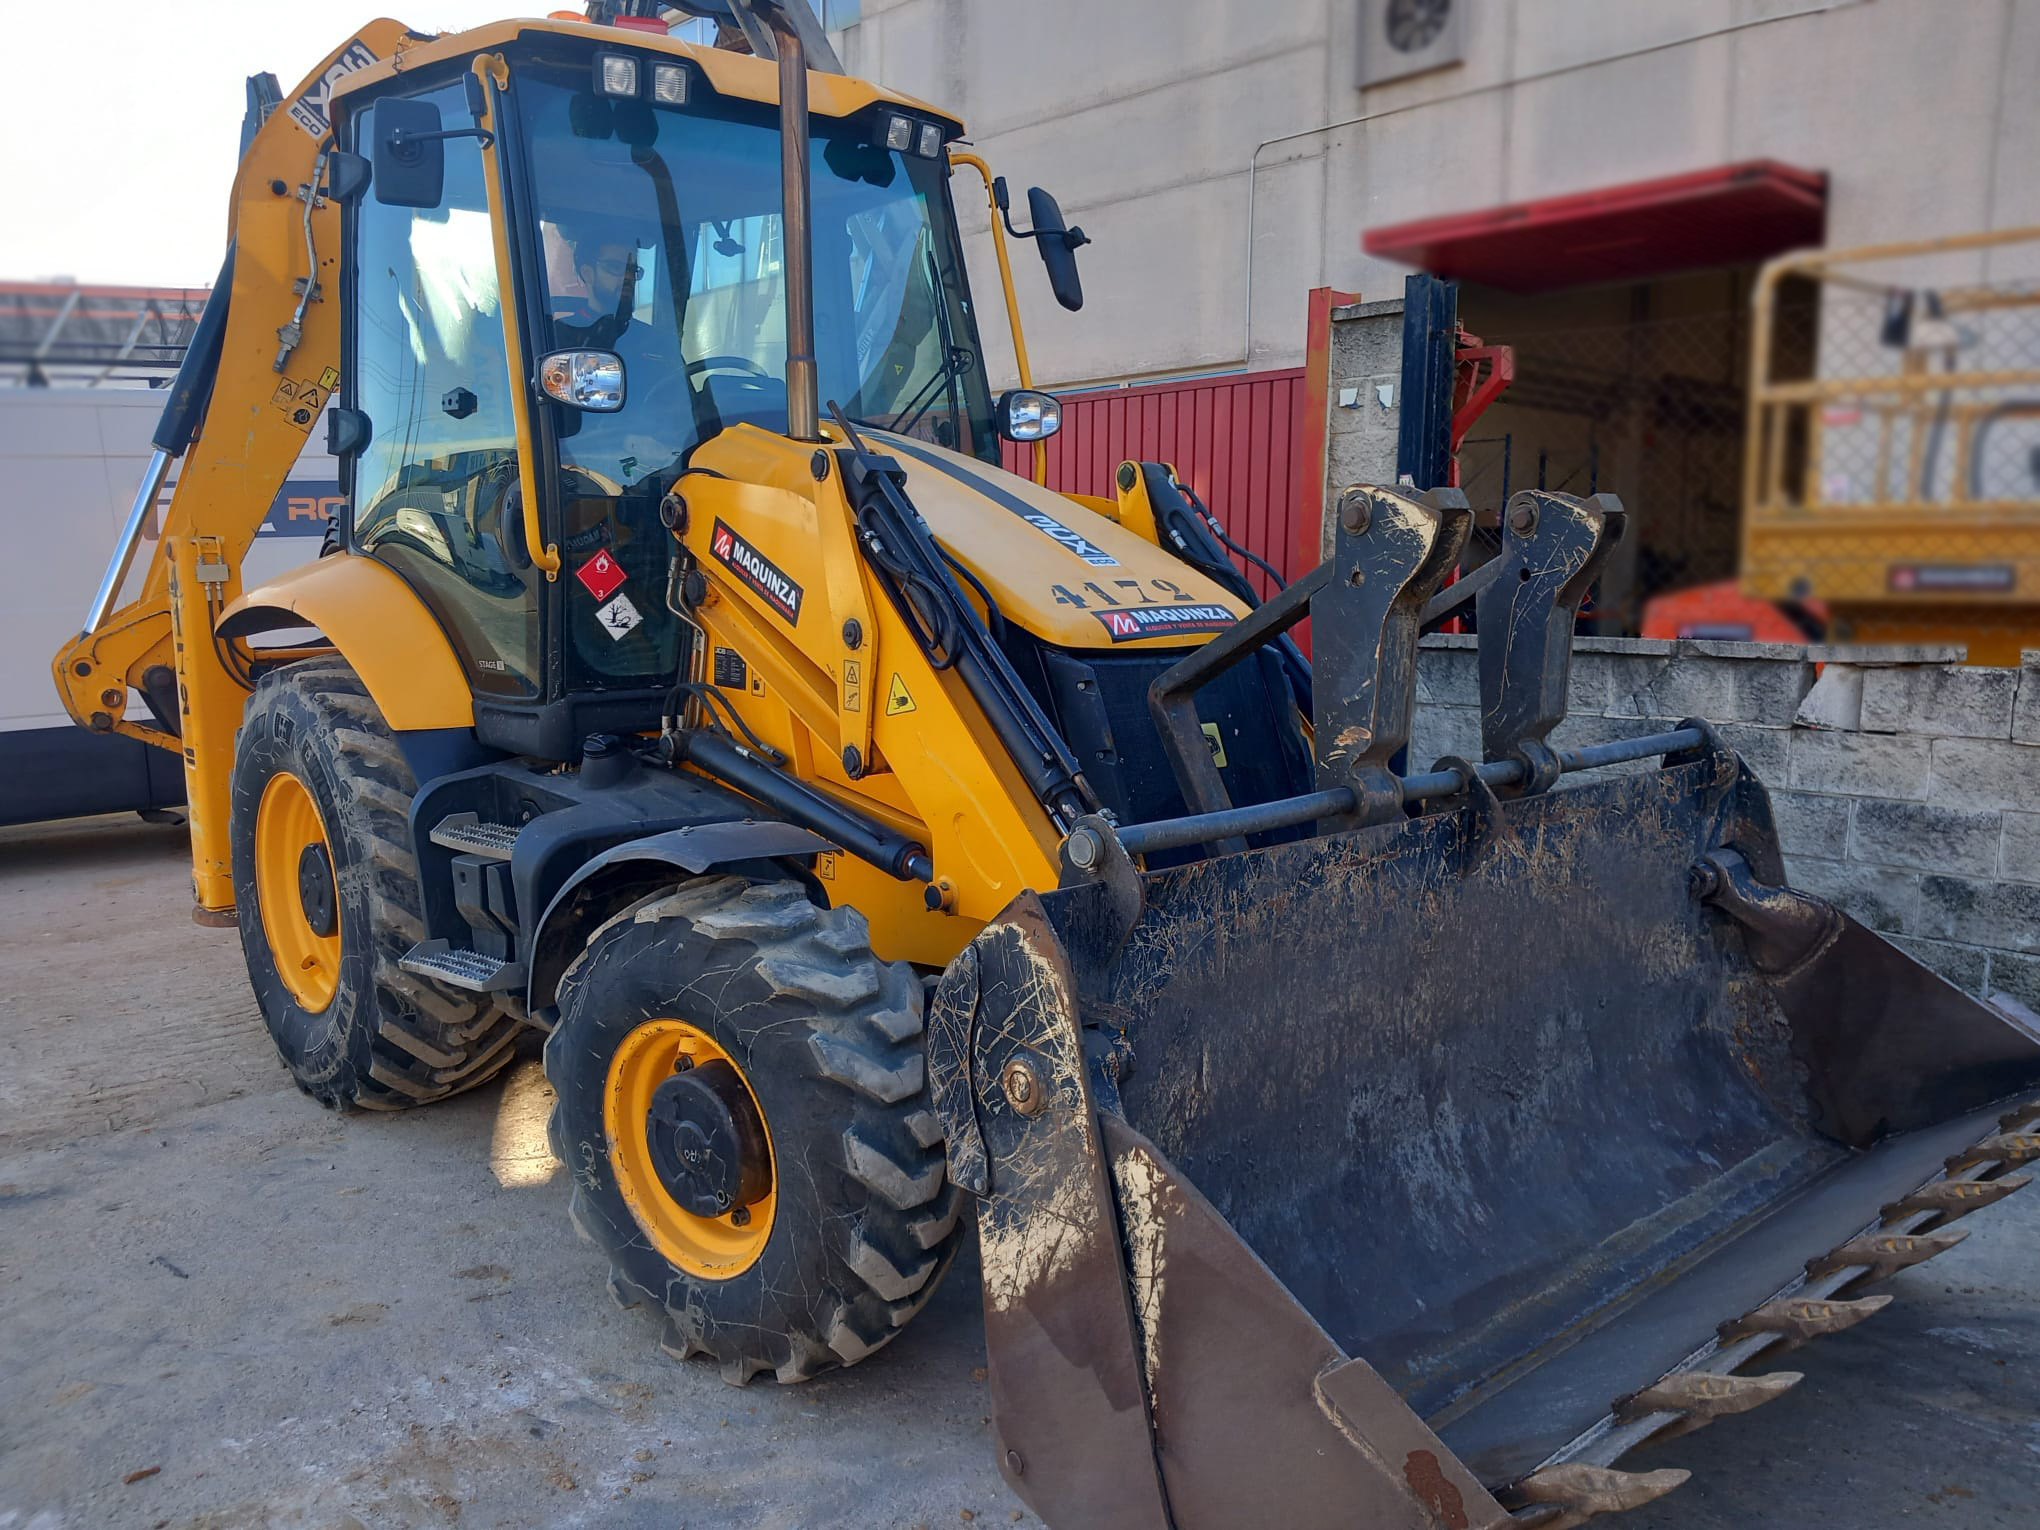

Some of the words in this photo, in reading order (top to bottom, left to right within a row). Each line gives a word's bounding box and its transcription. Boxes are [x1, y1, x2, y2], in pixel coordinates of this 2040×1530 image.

[291, 107, 321, 136] ECO
[733, 541, 796, 611] MAQUINZA
[598, 589, 604, 598] 3
[1051, 579, 1196, 609] 4172
[1129, 607, 1233, 624] MAQUINZA
